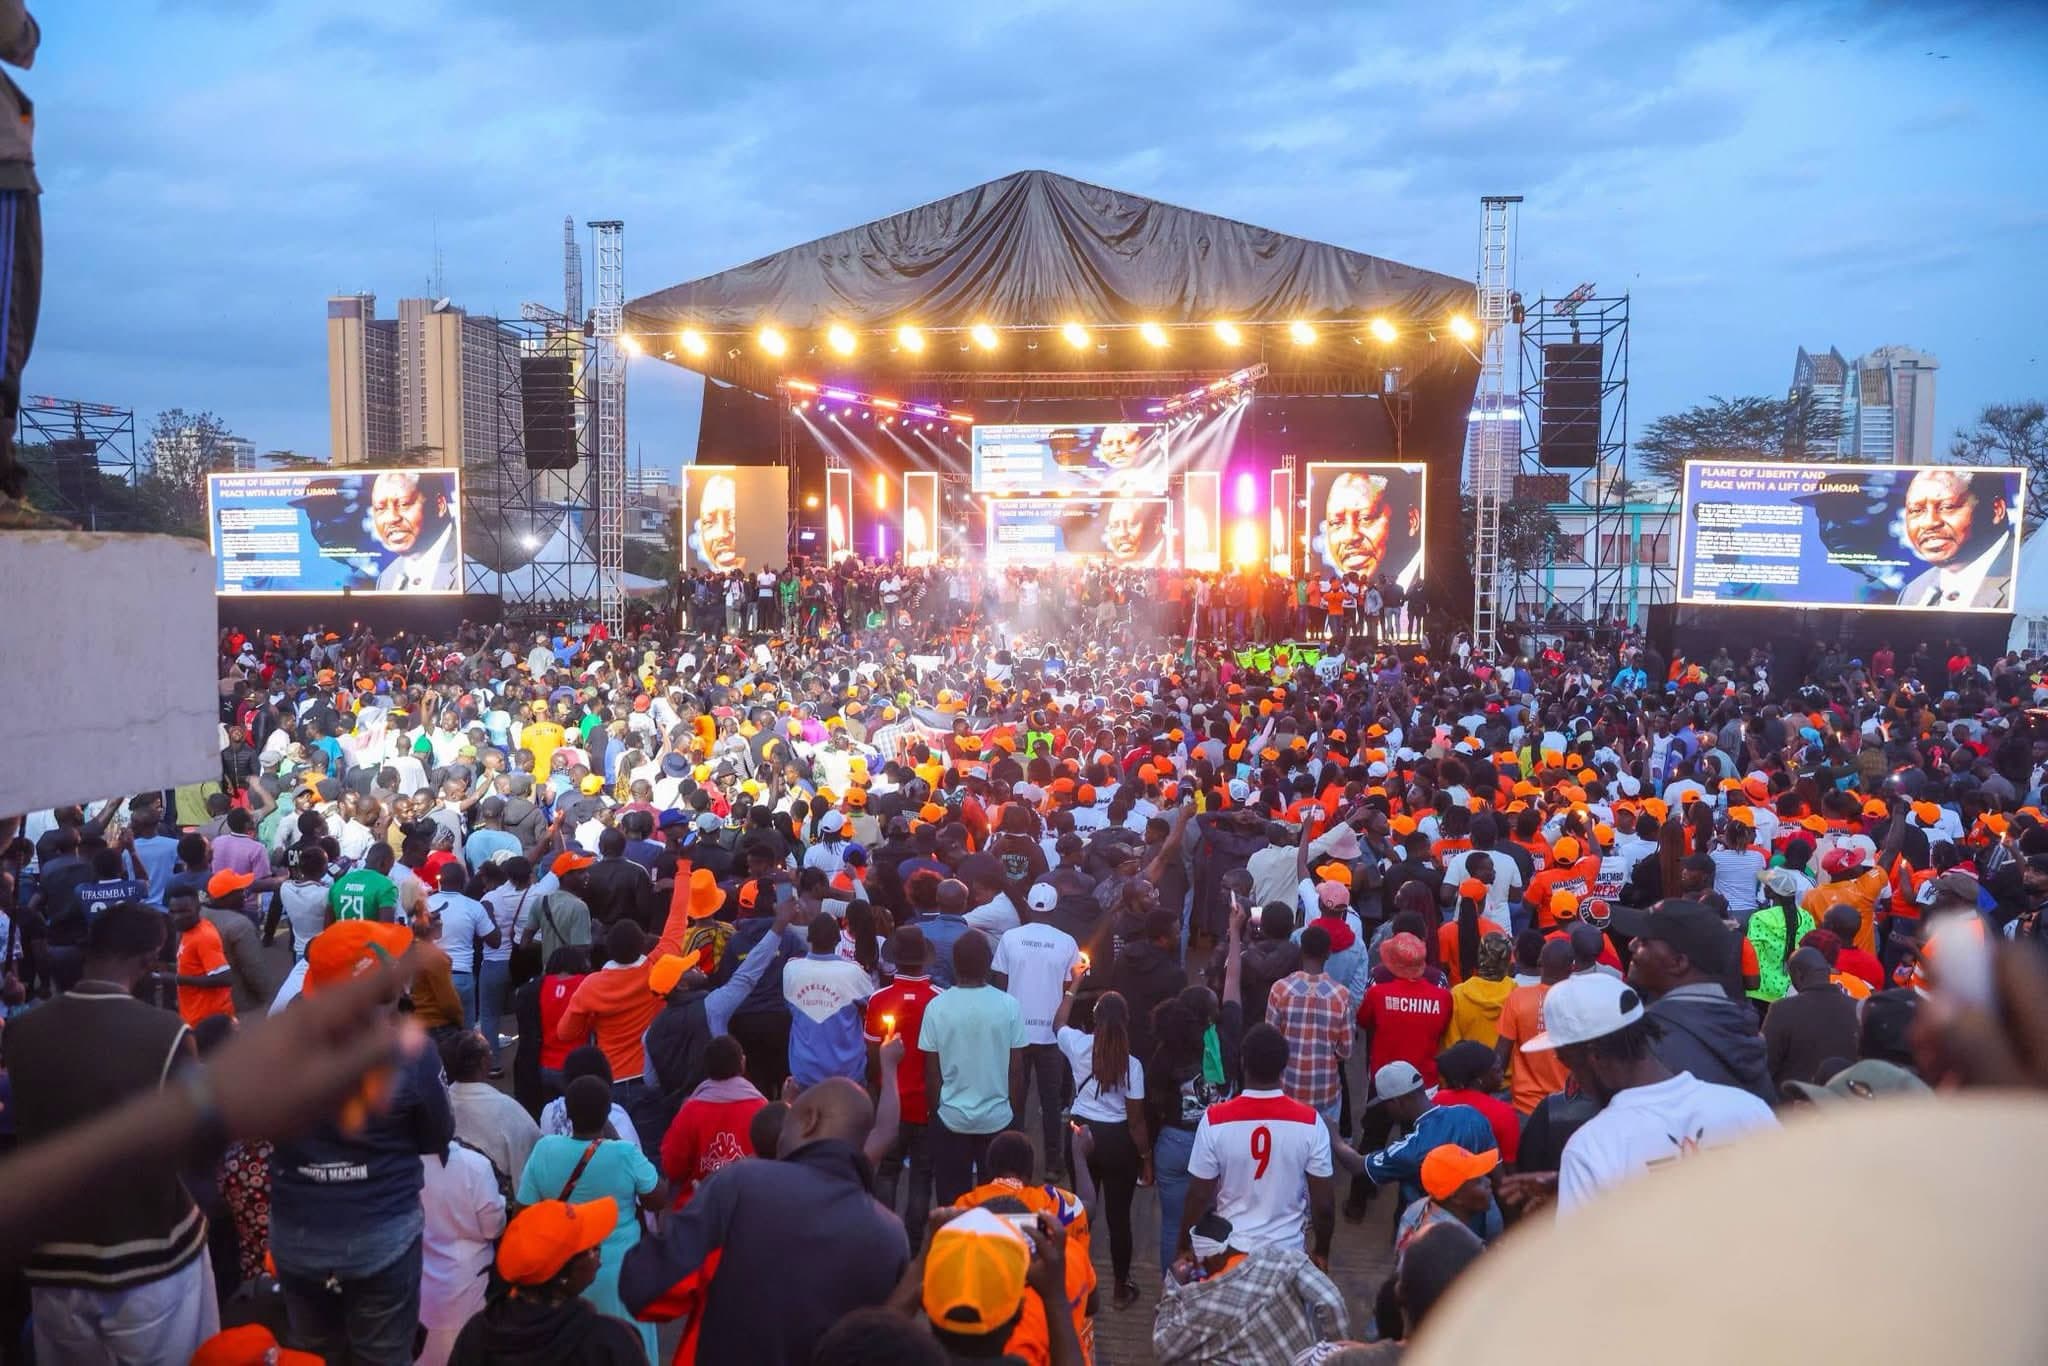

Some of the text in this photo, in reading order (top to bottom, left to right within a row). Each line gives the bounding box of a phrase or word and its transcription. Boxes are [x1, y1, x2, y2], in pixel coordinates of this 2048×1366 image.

[1701, 468, 1827, 480] FLAME OF LIBERTY AND
[1700, 480, 1860, 493] PEACE WITH A LIFT OF UMOJA
[1597, 872, 1624, 882] AREMBO
[1400, 997, 1440, 1015] CHINA
[1250, 1125, 1272, 1181] 9
